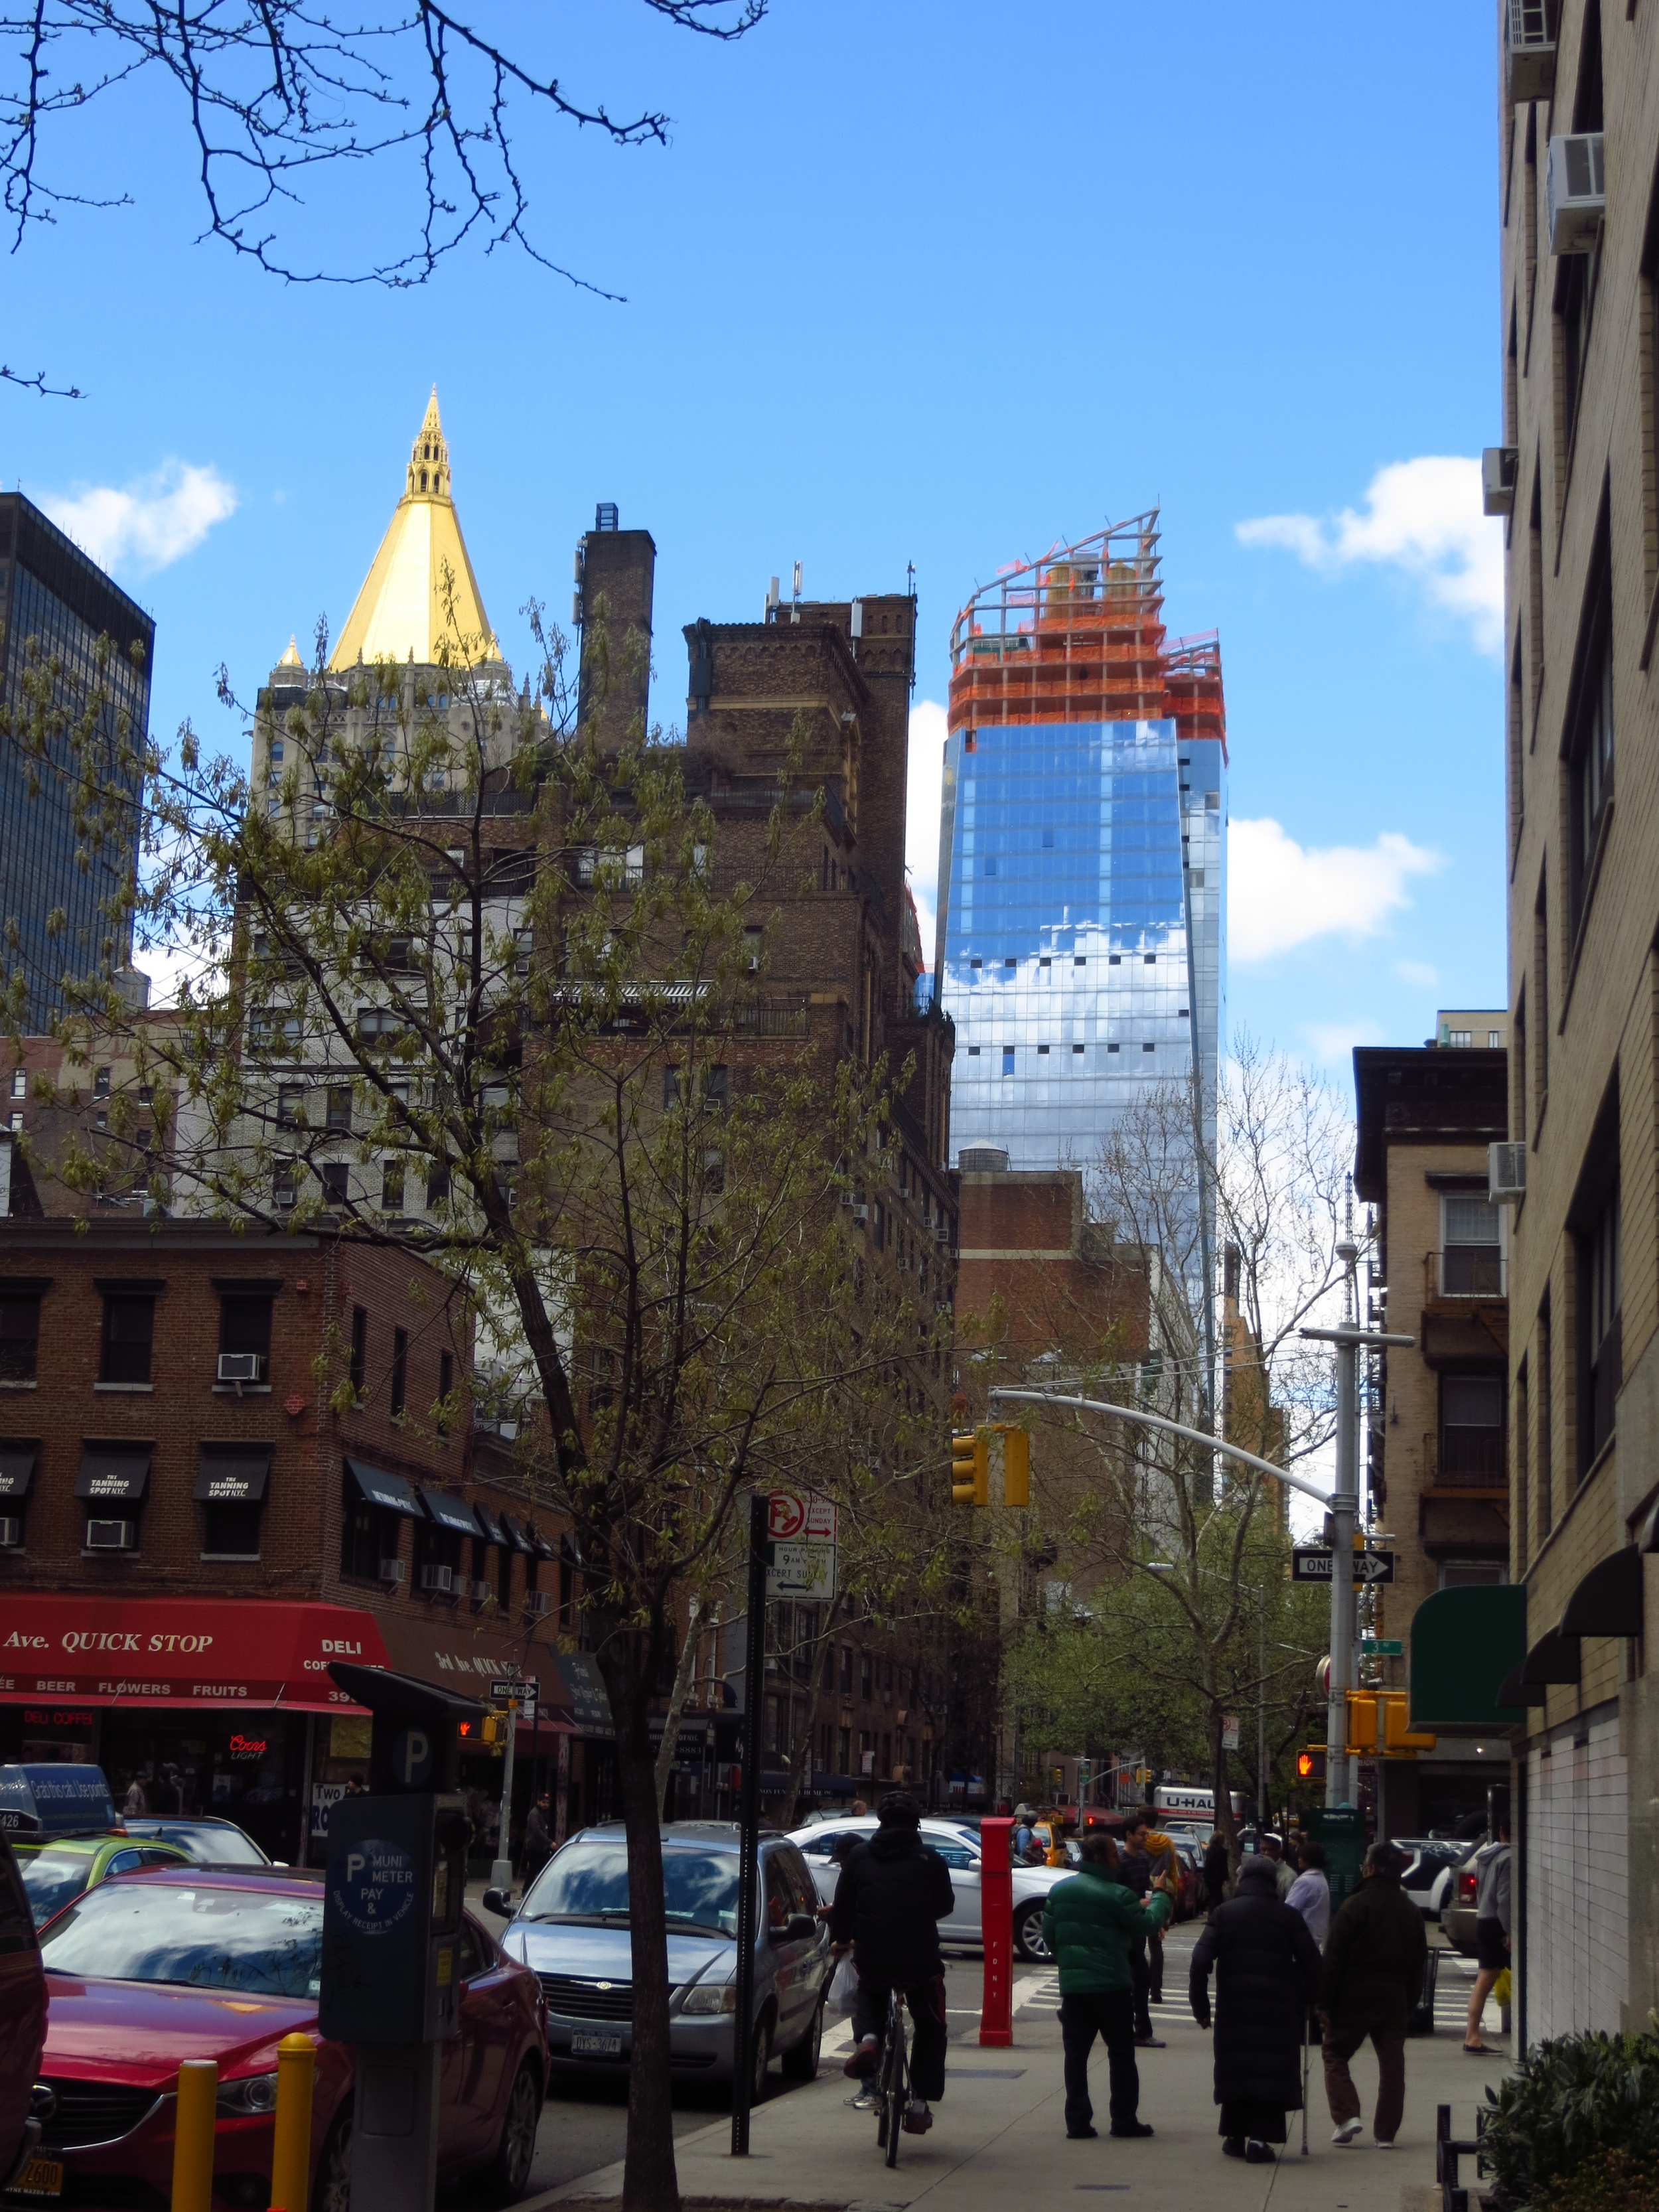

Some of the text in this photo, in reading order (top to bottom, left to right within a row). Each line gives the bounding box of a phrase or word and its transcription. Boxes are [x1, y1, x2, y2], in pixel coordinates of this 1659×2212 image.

[766, 1567, 792, 1578] XCEPT
[1307, 1560, 1333, 1572] ONE
[1, 1631, 213, 1653] Ave. QUICK STOP
[321, 1639, 362, 1655] DELI
[1372, 1641, 1379, 1653] 3
[472, 1657, 502, 1678] QUICK
[36, 1680, 76, 1692] BEER
[98, 1682, 171, 1695] FLOWERS
[192, 1685, 248, 1697] FRUITS
[497, 1686, 512, 1695] ONE
[328, 1692, 358, 1704] 39
[24, 1710, 48, 1725] DELI
[230, 1734, 267, 1752] Coors
[230, 1751, 265, 1760] LIGHT
[0, 1814, 19, 1828] 426
[372, 1856, 402, 1867] MUNI
[372, 1871, 413, 1883] METER
[361, 1887, 384, 1900] PAY
[333, 1889, 414, 1930] DISPLAY RECEIPT IN VEHICLE
[367, 1902, 377, 1915] &
